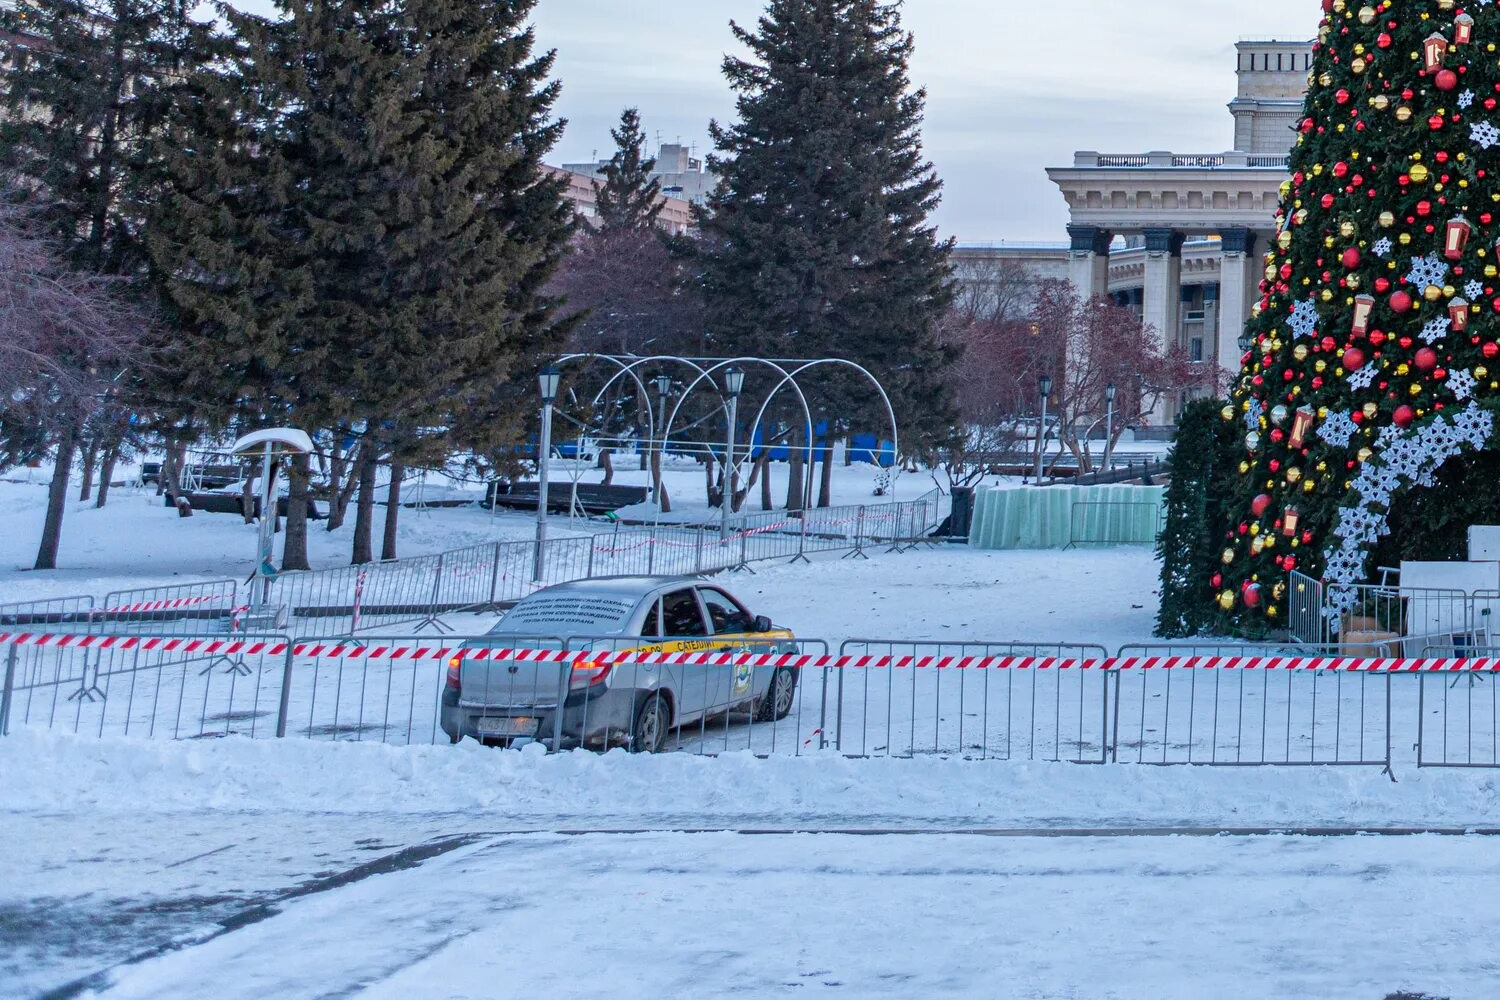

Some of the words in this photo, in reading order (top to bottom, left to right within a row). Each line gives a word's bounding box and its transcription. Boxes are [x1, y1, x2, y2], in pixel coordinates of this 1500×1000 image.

[580, 604, 626, 615] СЛОЖНОСТИ
[603, 599, 634, 609] ОХРАНЫ
[555, 610, 620, 621] СОПРОВОЖДЕНИИ
[677, 640, 716, 652] САТЕЛЛИТ
